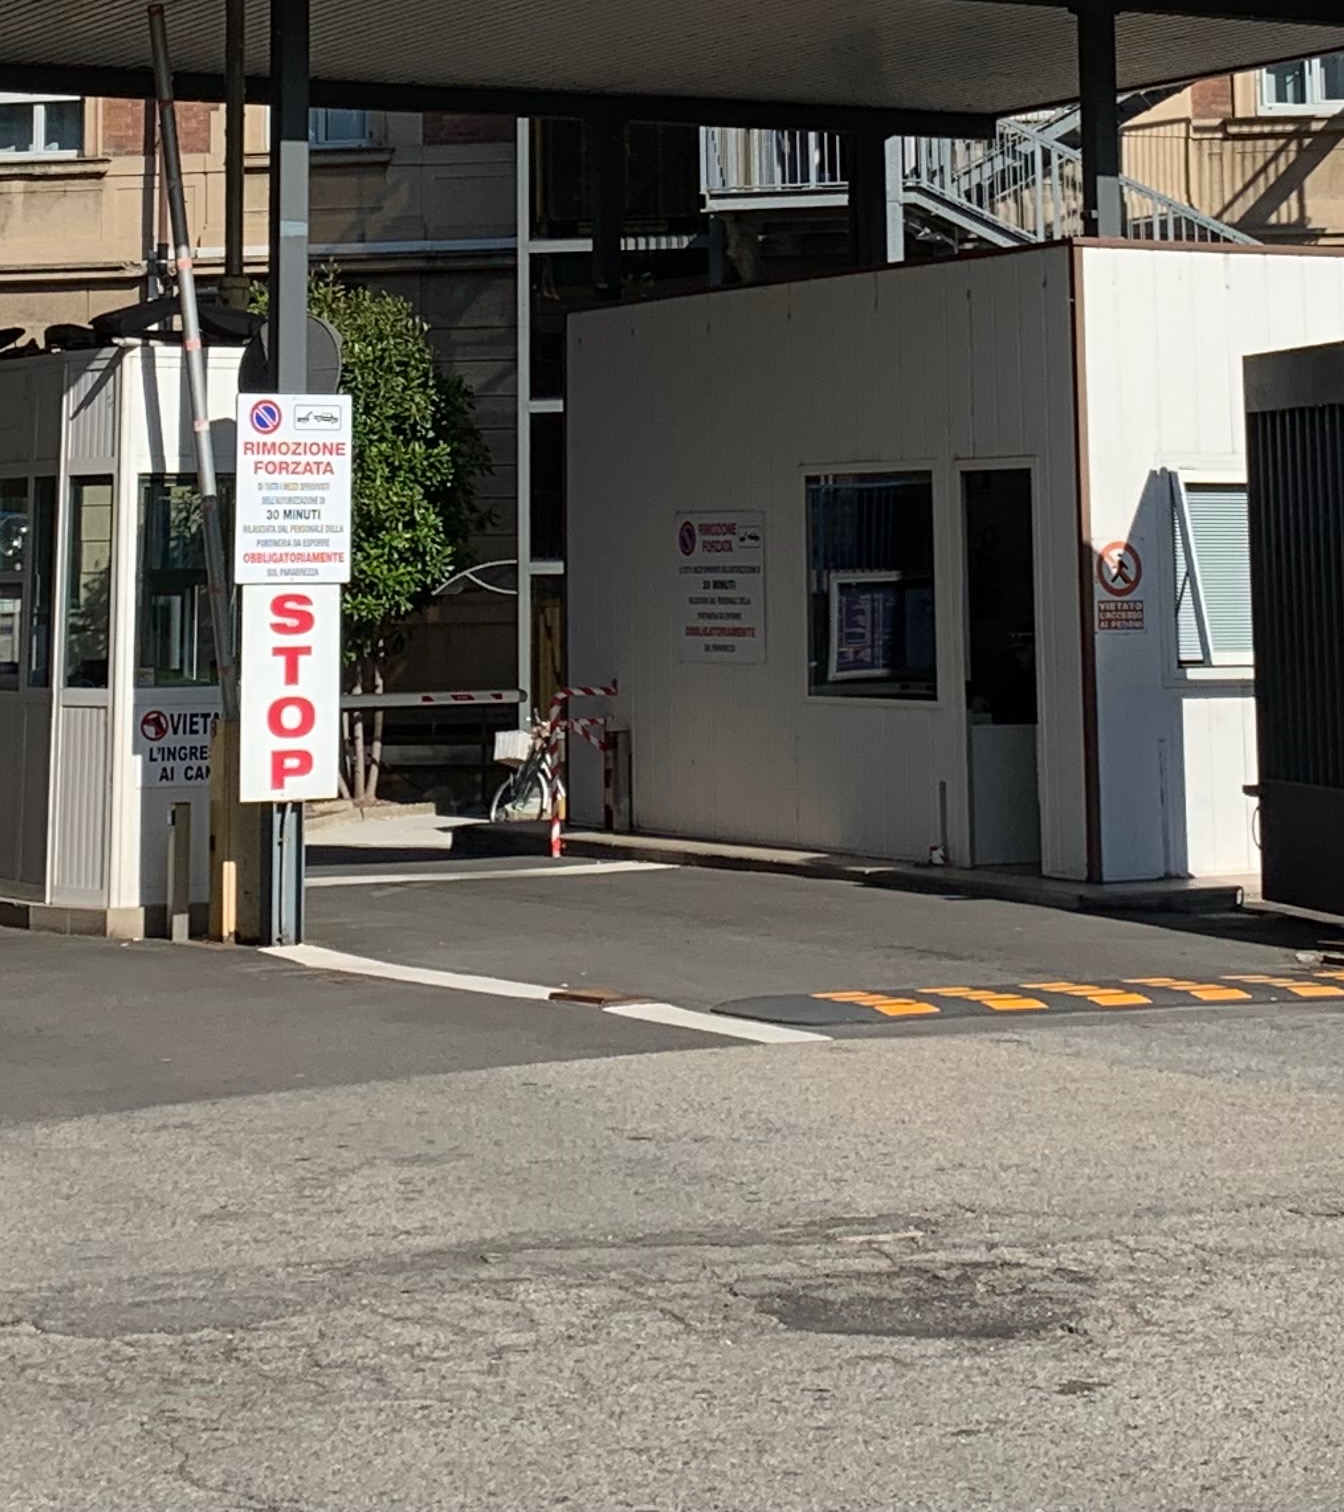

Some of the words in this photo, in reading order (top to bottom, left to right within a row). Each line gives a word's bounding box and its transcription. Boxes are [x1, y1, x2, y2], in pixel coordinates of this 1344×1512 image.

[243, 441, 346, 456] RIMOZIONE
[254, 461, 335, 475] FORZATA
[266, 509, 279, 520] 30
[282, 509, 322, 520] MINUTI
[243, 552, 345, 564] OBBLIGATORIAMENTE
[267, 593, 315, 791] STOP
[149, 745, 211, 762] L'INGRE
[159, 766, 174, 782] AI
